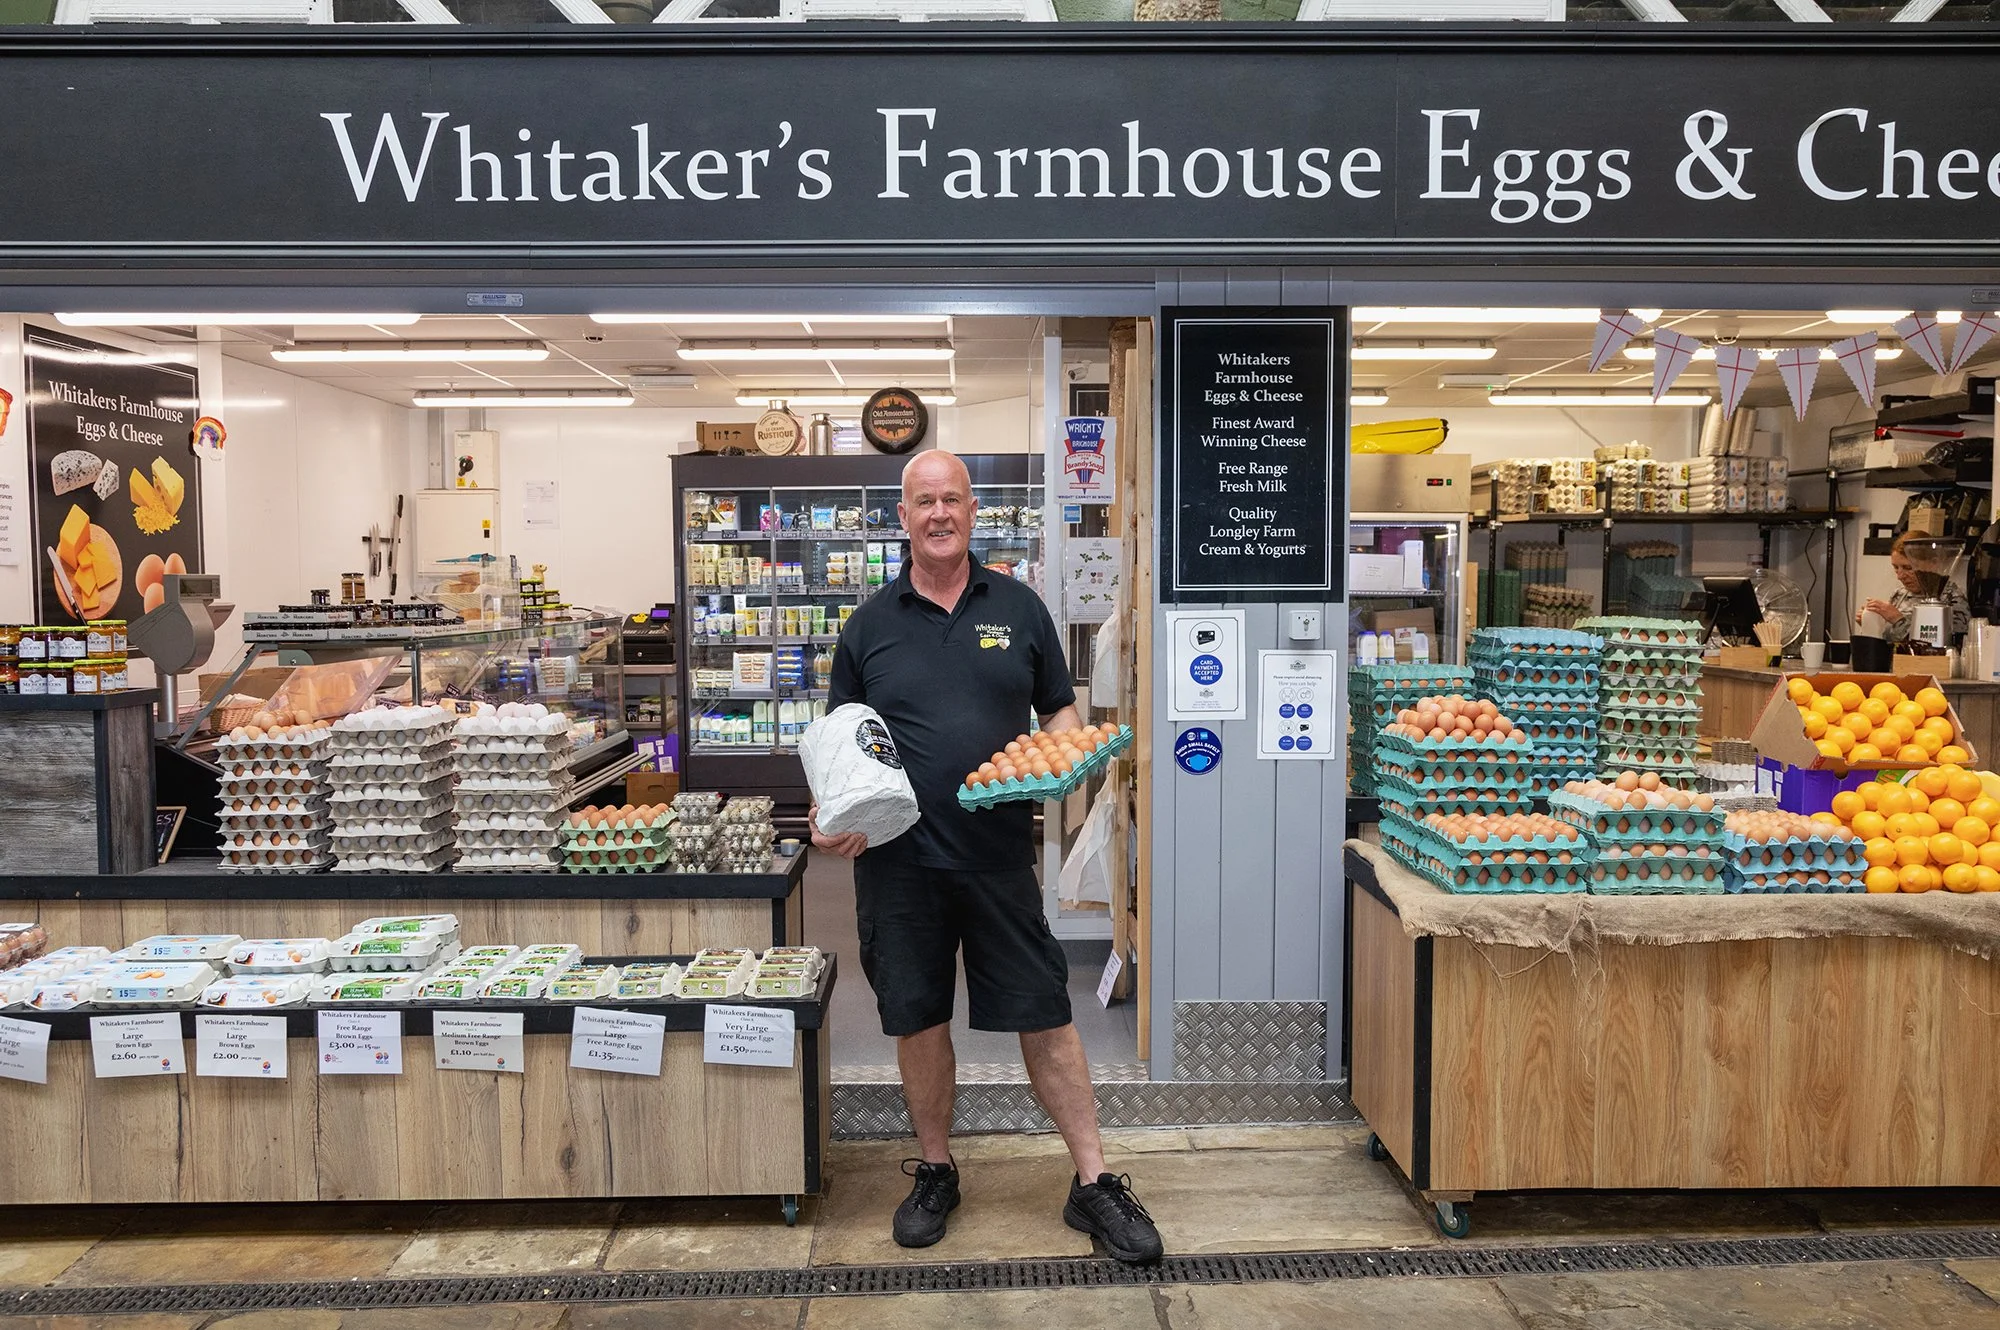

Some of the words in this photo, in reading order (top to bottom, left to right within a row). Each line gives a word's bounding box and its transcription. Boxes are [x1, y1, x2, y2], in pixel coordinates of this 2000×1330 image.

[320, 112, 832, 202] Whitaker's
[876, 107, 1382, 199] Farmhouse
[1419, 108, 1632, 223] Eggs
[1675, 109, 1757, 200] &
[1217, 353, 1291, 366] Whitakers
[1215, 371, 1293, 384] Farmhouse
[49, 380, 117, 412] Whitakers
[120, 394, 184, 424] Farmhouse
[1204, 390, 1236, 406] Eggs
[1239, 390, 1250, 402] &
[1254, 390, 1304, 402] Cheese
[1068, 423, 1102, 433] WRIGHT'S
[1212, 417, 1251, 429] Finest
[1254, 416, 1295, 429] Award
[76, 415, 106, 442] Eggs
[109, 421, 119, 440] &
[121, 423, 163, 446] Cheese
[1200, 435, 1258, 450] Winning
[1261, 435, 1306, 447] Cheese
[1218, 462, 1246, 474] Free
[1249, 462, 1288, 477] Range
[1219, 480, 1254, 492] Fresh
[1257, 480, 1287, 492] Milk
[1228, 507, 1277, 522] Quality
[1210, 525, 1260, 540] Longley
[1263, 525, 1296, 537] Farm
[1200, 543, 1241, 555] Cream
[1244, 544, 1254, 555] &
[1257, 543, 1306, 558] Yogurts
[1176, 745, 1187, 755] SHOP
[1204, 743, 1220, 753] SAFELY
[581, 1016, 615, 1024] Whitakers
[616, 1019, 652, 1028] Farmhouse
[725, 1023, 744, 1032] Very
[746, 1024, 768, 1033] Large
[604, 1031, 627, 1040] Large
[758, 1034, 774, 1042] Eggs
[329, 1042, 355, 1050] £3.00
[604, 1039, 625, 1048] Range
[112, 1052, 137, 1061] £2.60
